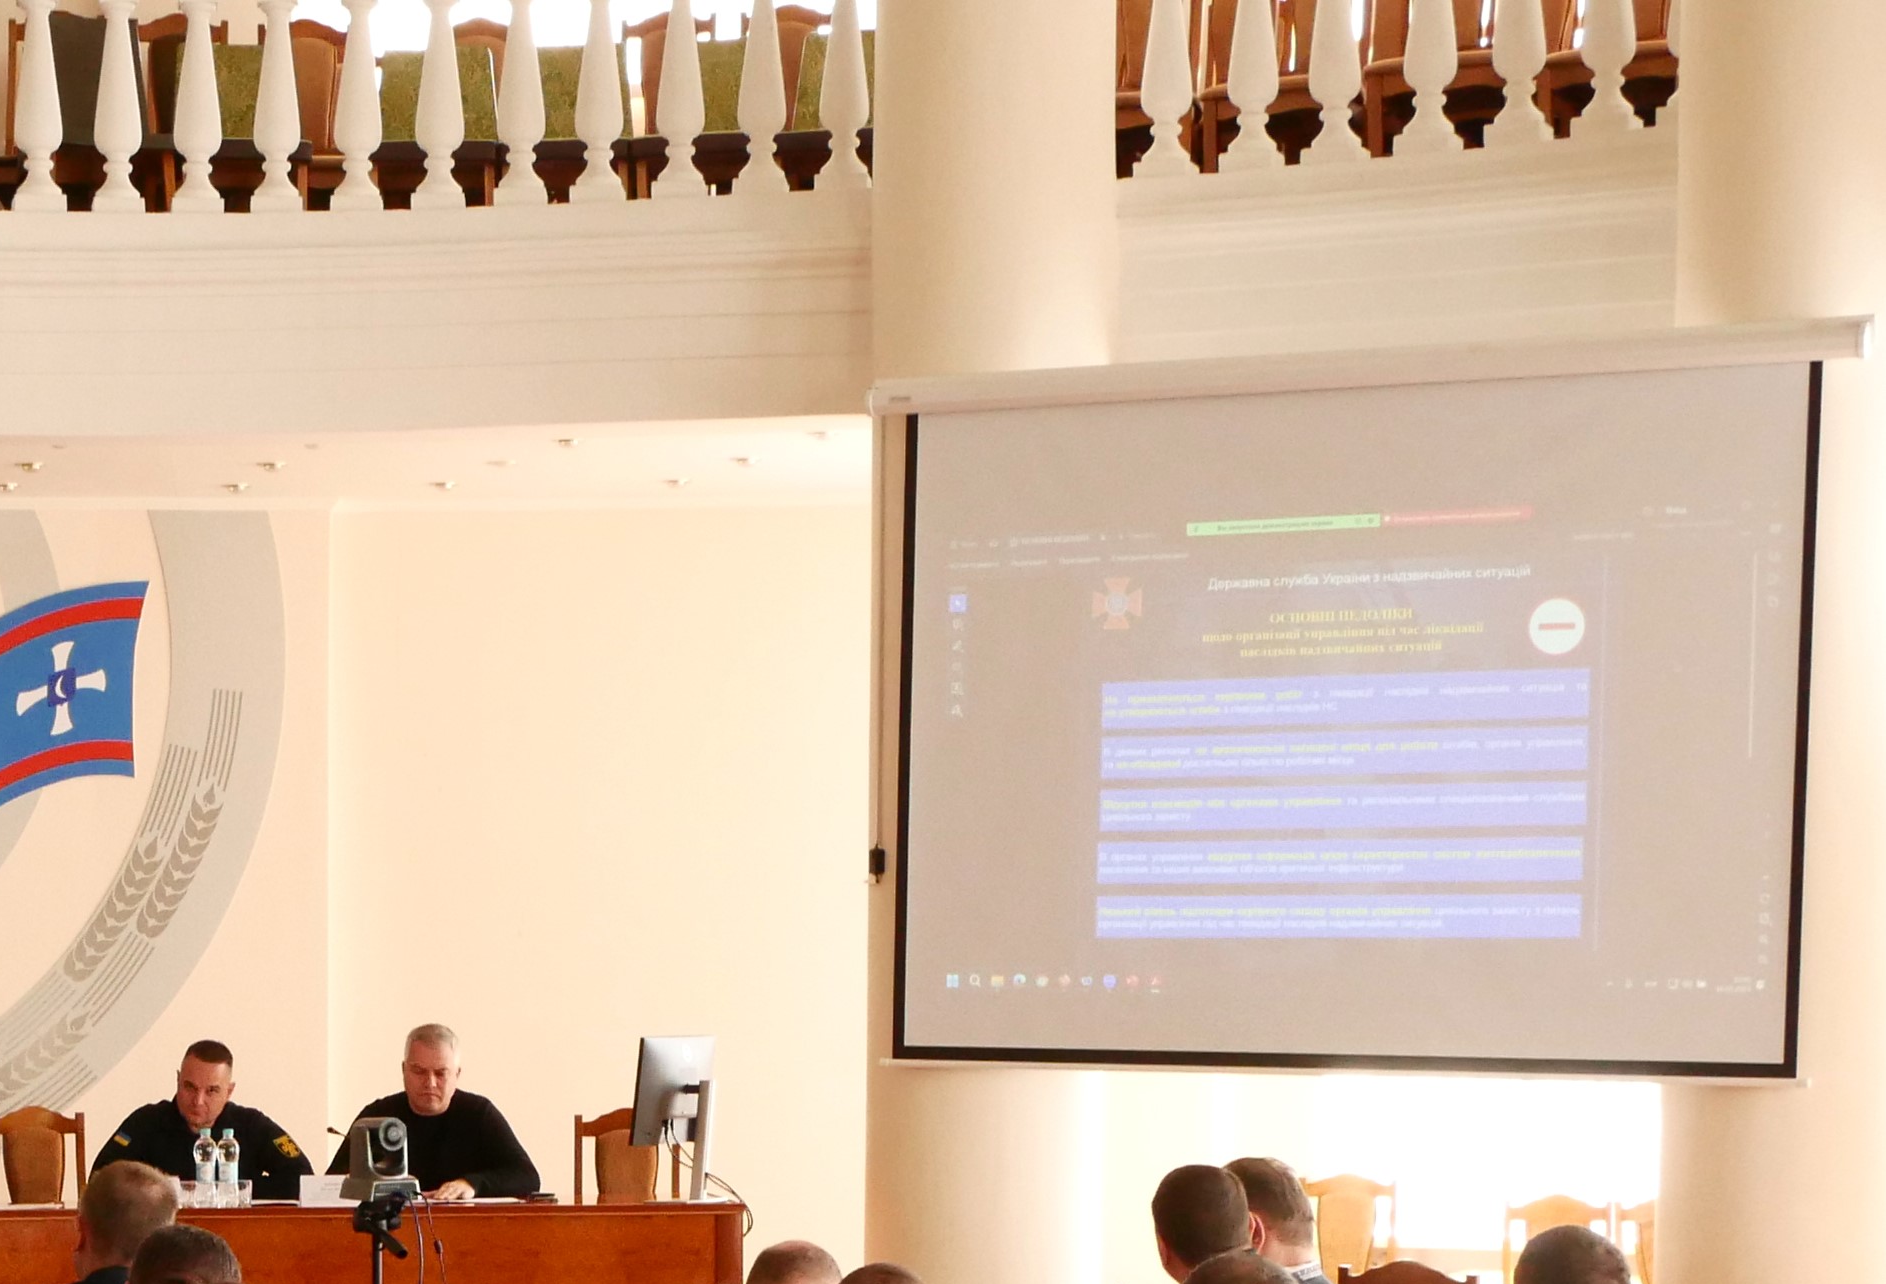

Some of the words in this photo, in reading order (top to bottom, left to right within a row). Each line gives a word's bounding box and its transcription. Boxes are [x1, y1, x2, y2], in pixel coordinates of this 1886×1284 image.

[1207, 577, 1270, 591] Державна
[1272, 574, 1319, 588] служба
[1322, 572, 1370, 586] України
[1382, 568, 1473, 583] надзвичайних
[1475, 564, 1532, 580] ситуацій
